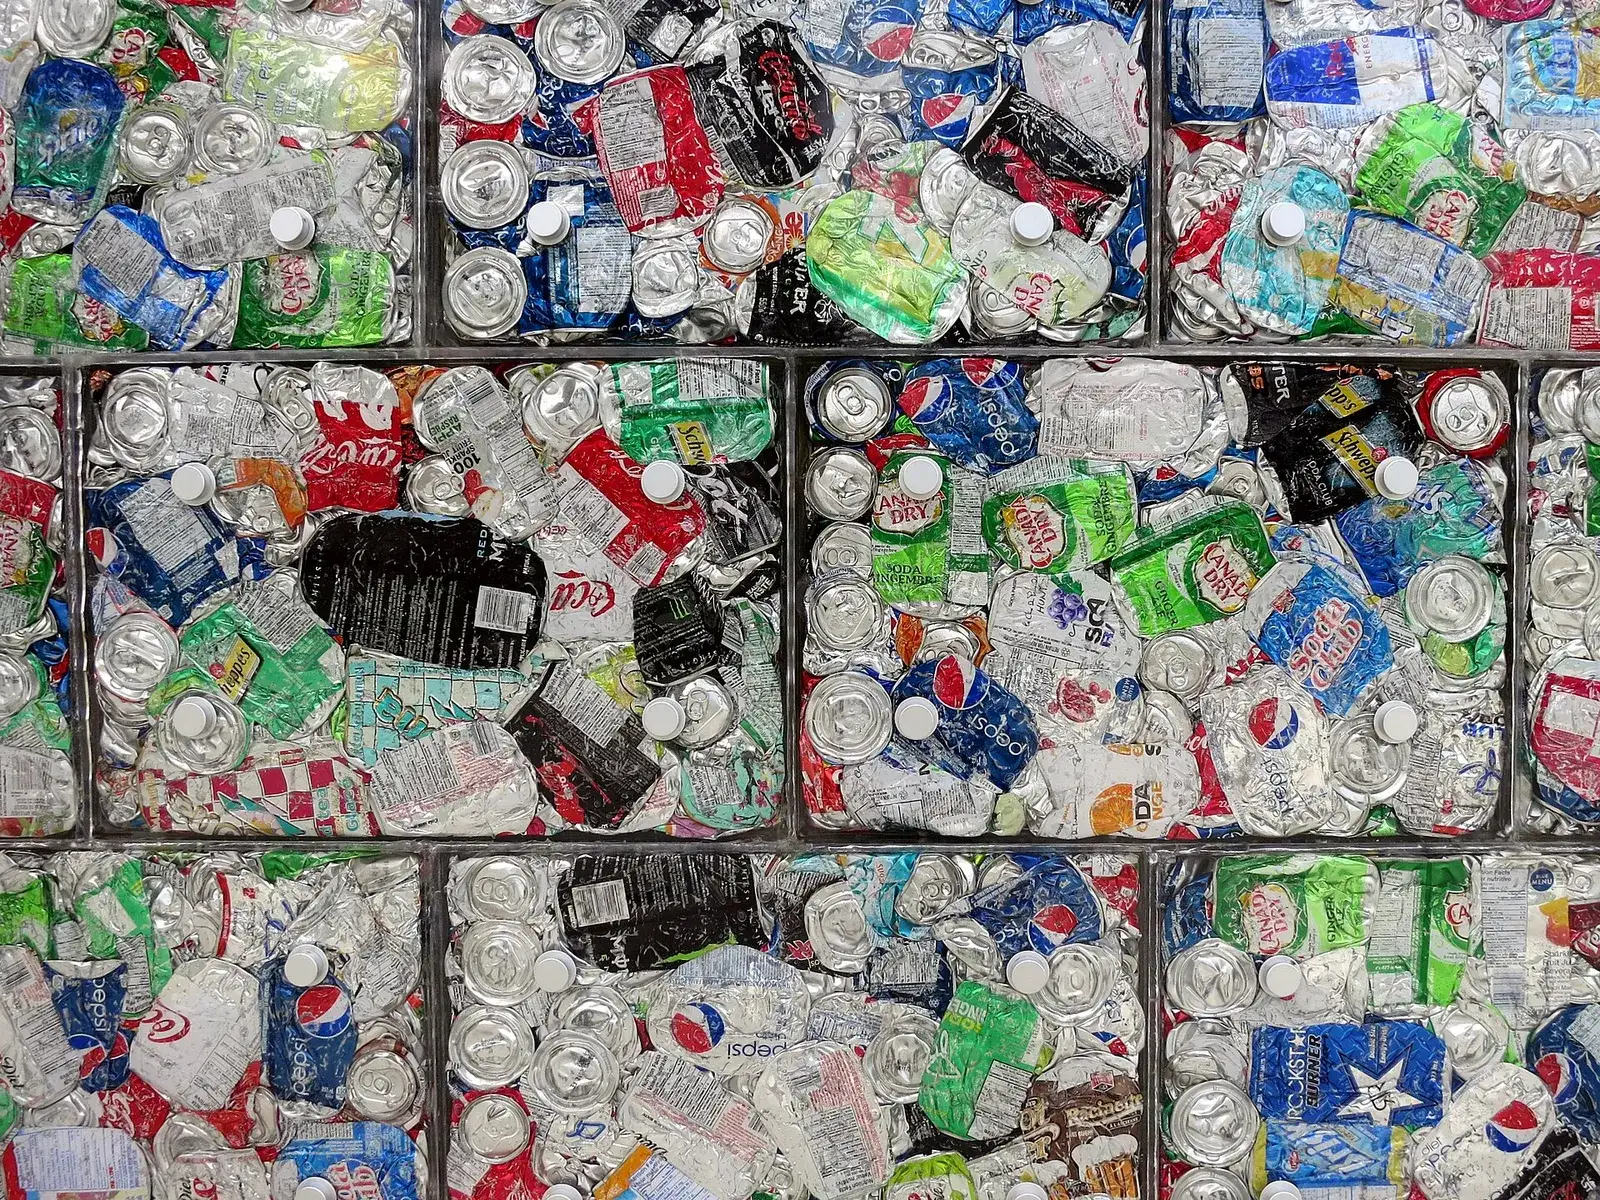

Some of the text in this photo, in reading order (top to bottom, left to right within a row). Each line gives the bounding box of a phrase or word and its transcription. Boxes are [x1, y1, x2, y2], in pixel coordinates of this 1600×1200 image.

[1362, 36, 1373, 69] ENERG
[1438, 191, 1468, 238] CANA
[429, 413, 460, 435] RASPBE
[432, 423, 463, 445] APP
[980, 397, 1020, 458] pepsi
[444, 444, 476, 467] SPARKL
[891, 504, 928, 525] DRY
[1011, 496, 1052, 568] CANADA
[1030, 509, 1057, 543] DRY
[887, 563, 922, 575] SODA
[1203, 567, 1236, 602] DRY
[549, 579, 616, 618] Coca
[750, 577, 775, 600] TASTE
[1154, 579, 1179, 627] GINGER
[1289, 596, 1350, 678] Soda
[1310, 617, 1363, 691] Club
[971, 713, 1028, 756] pepsi
[317, 787, 331, 820] tea
[1261, 758, 1294, 814] pepsi
[1531, 878, 1553, 886] MENU
[1324, 895, 1336, 943] GINGER
[90, 977, 107, 1032] pepsi
[292, 1036, 310, 1097] pepsi
[727, 1040, 787, 1060] pepsi
[2, 1056, 25, 1088] Diet
[1304, 1032, 1322, 1108] BURNER
[1421, 1136, 1442, 1155] diet
